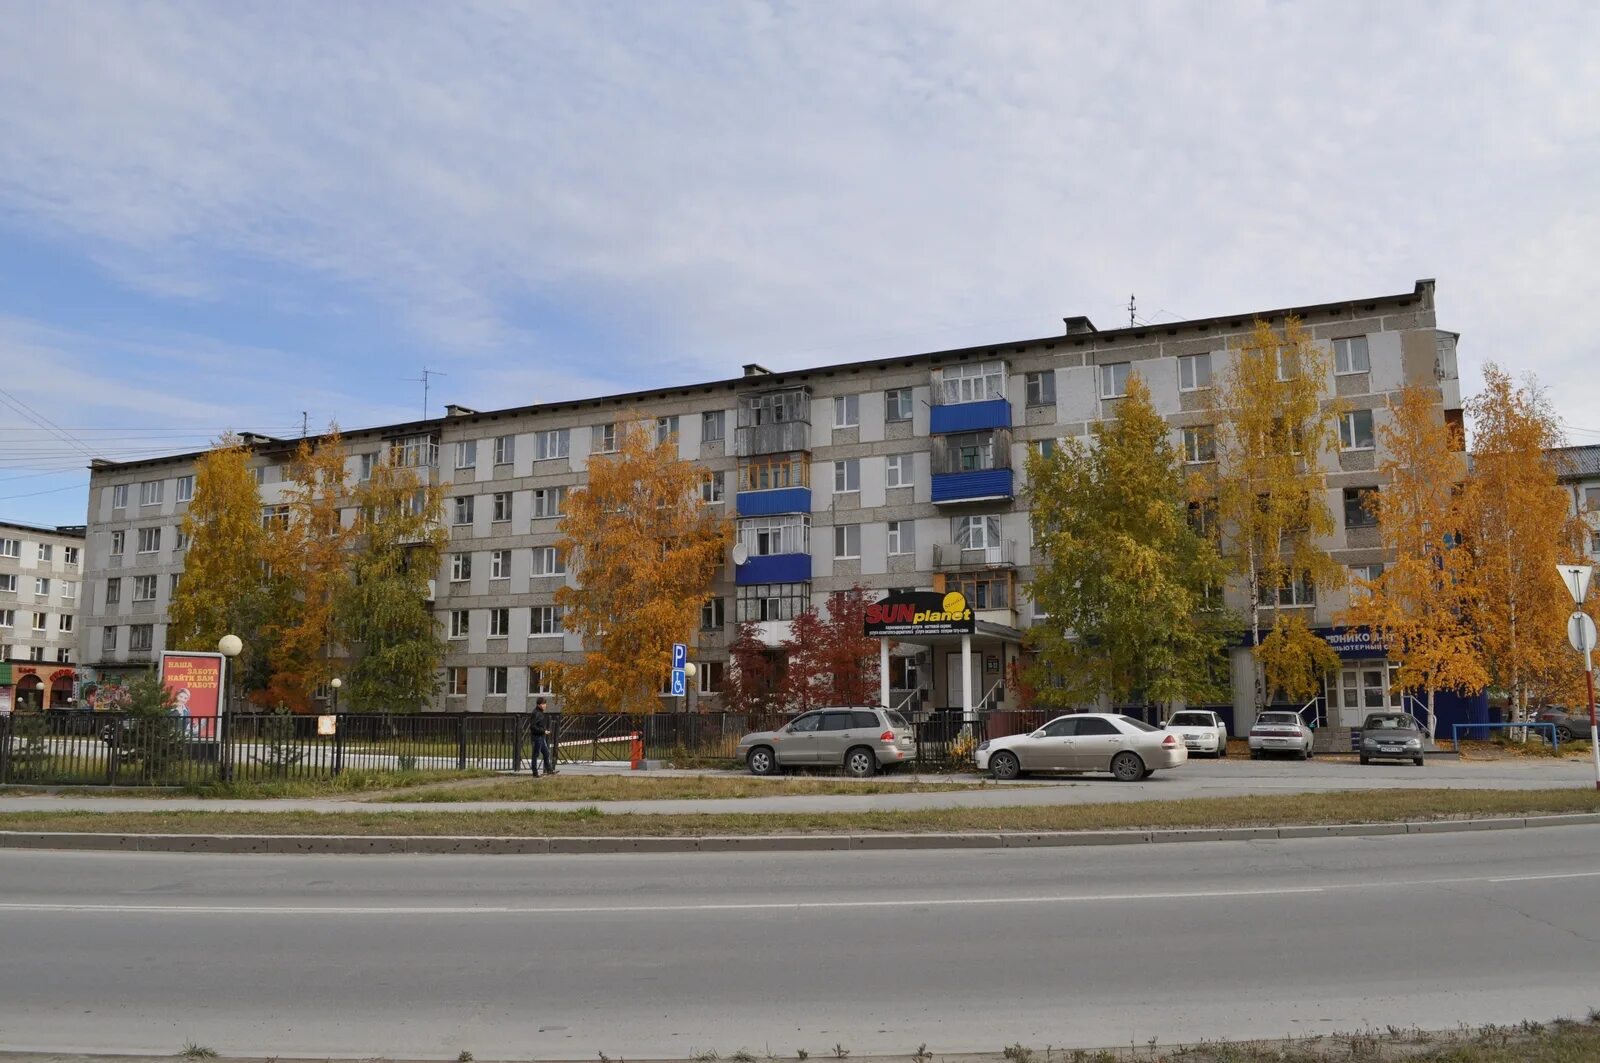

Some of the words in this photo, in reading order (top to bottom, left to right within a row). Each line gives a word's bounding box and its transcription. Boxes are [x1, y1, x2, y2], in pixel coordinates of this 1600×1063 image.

[866, 604, 914, 623] SUN
[914, 609, 971, 624] planet
[675, 646, 683, 667] P
